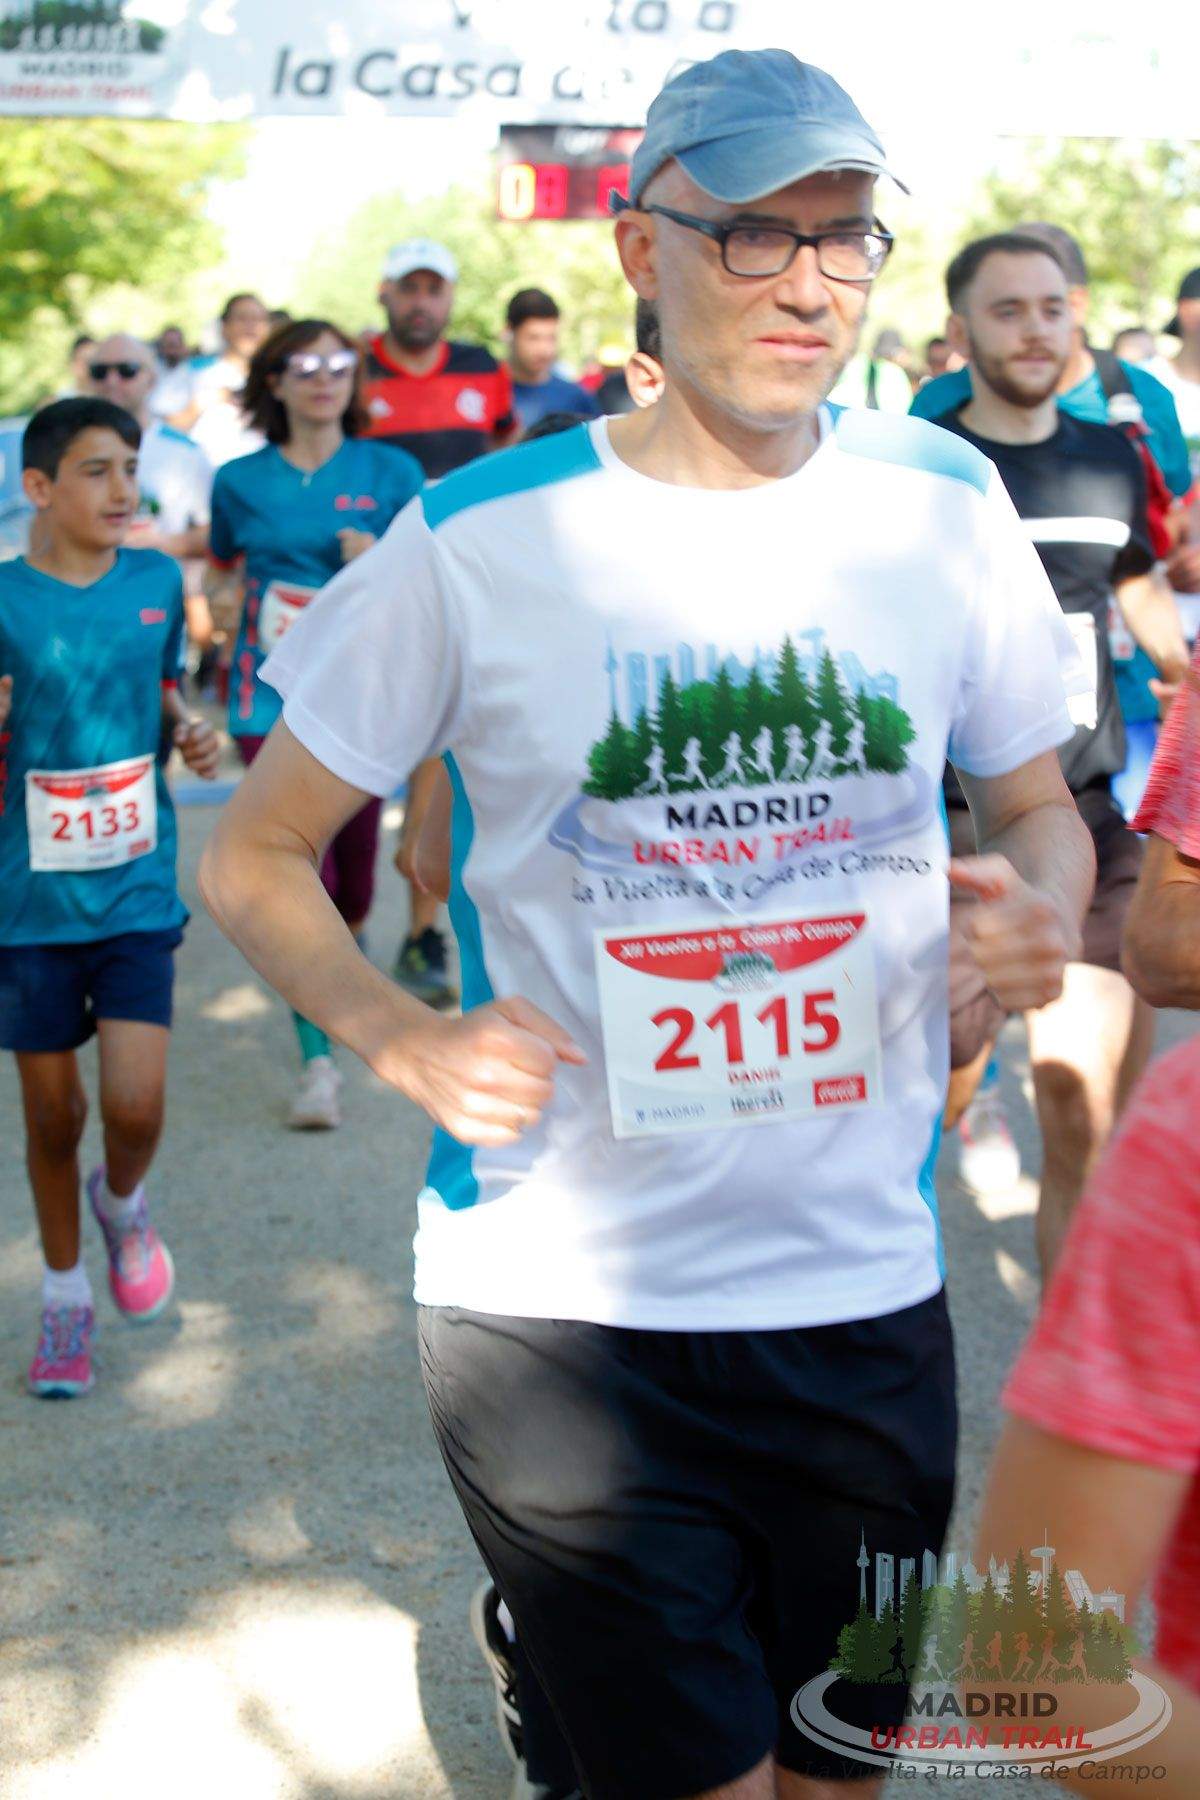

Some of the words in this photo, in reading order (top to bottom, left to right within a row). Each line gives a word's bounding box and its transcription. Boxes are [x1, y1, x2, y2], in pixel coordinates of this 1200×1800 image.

[271, 42, 335, 97] la
[354, 48, 523, 99] Casa
[51, 800, 140, 842] 2133
[665, 791, 832, 832] MADRID
[632, 836, 761, 868] URBAN
[771, 817, 857, 861] TRAIL
[649, 990, 842, 1073] 2115
